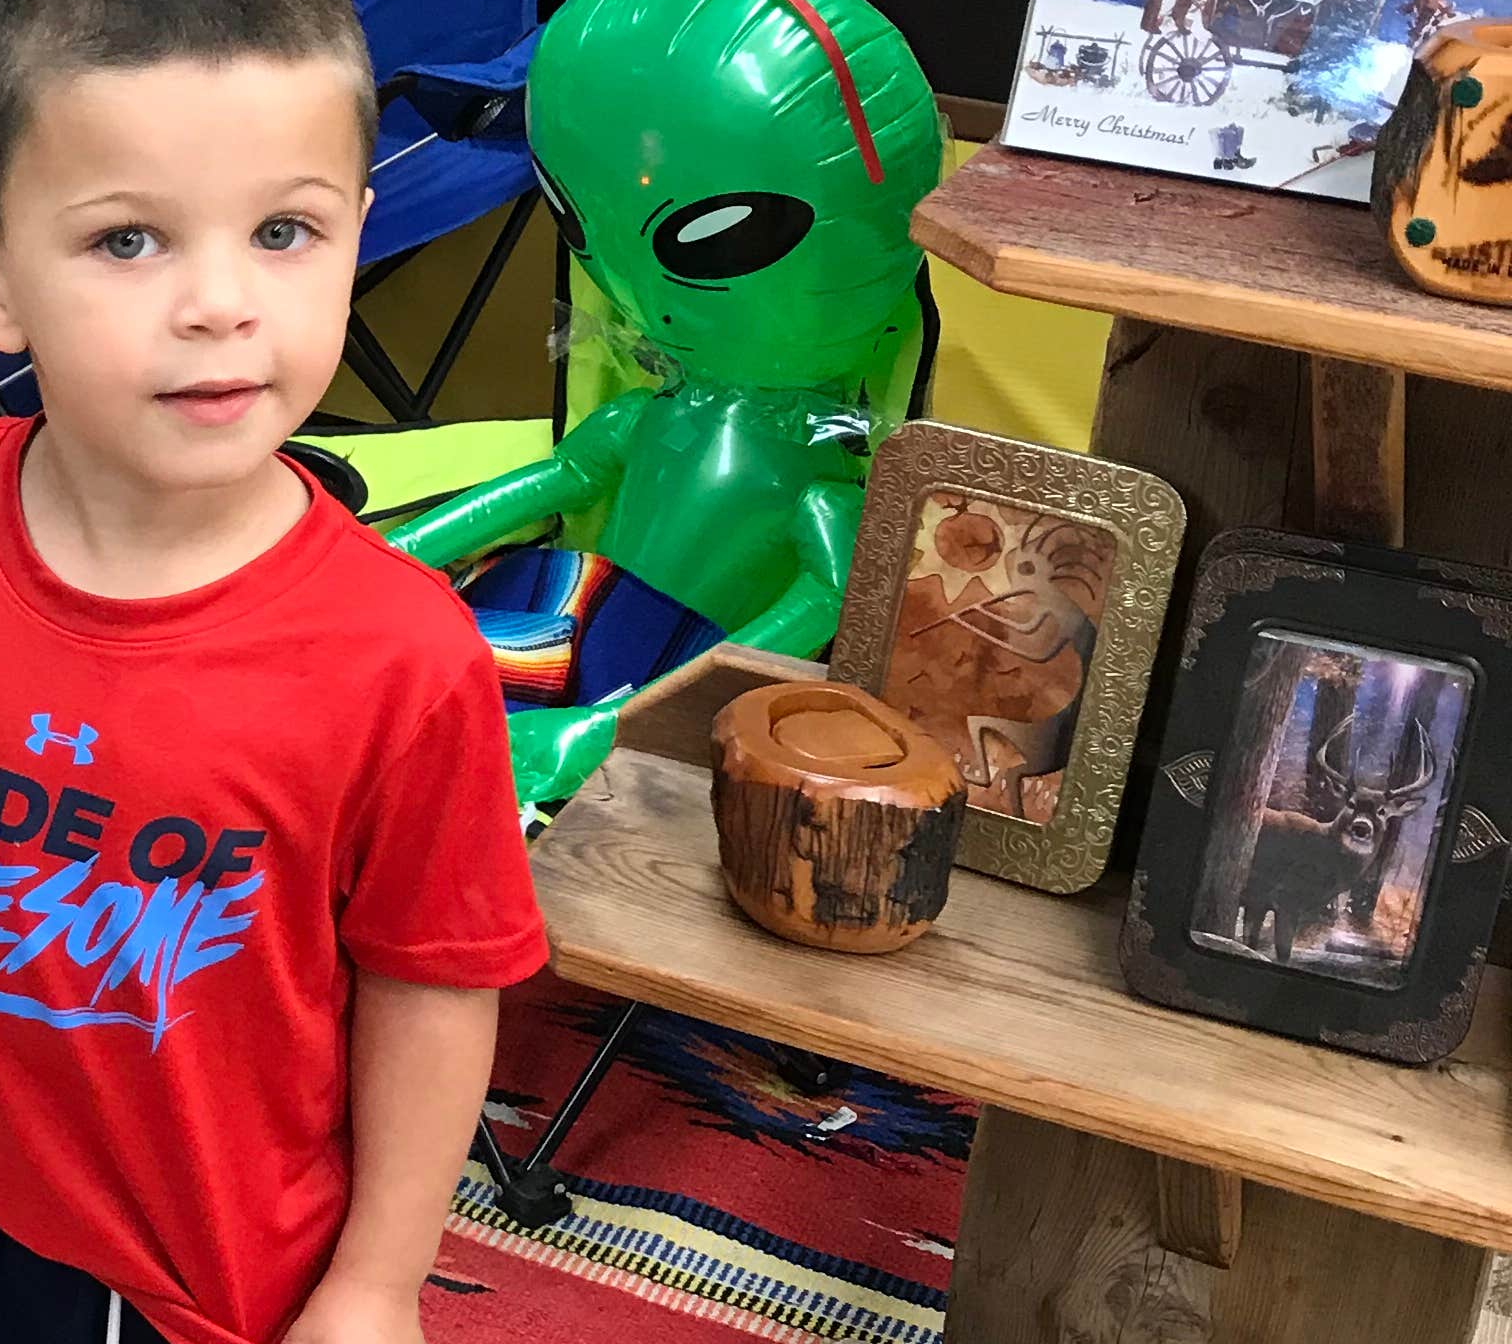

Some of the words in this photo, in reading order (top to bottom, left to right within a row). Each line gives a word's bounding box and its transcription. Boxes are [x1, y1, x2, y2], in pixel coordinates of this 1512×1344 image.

[1020, 104, 1091, 138] Merry
[1096, 114, 1196, 146] Christmas!
[128, 815, 267, 891] OF
